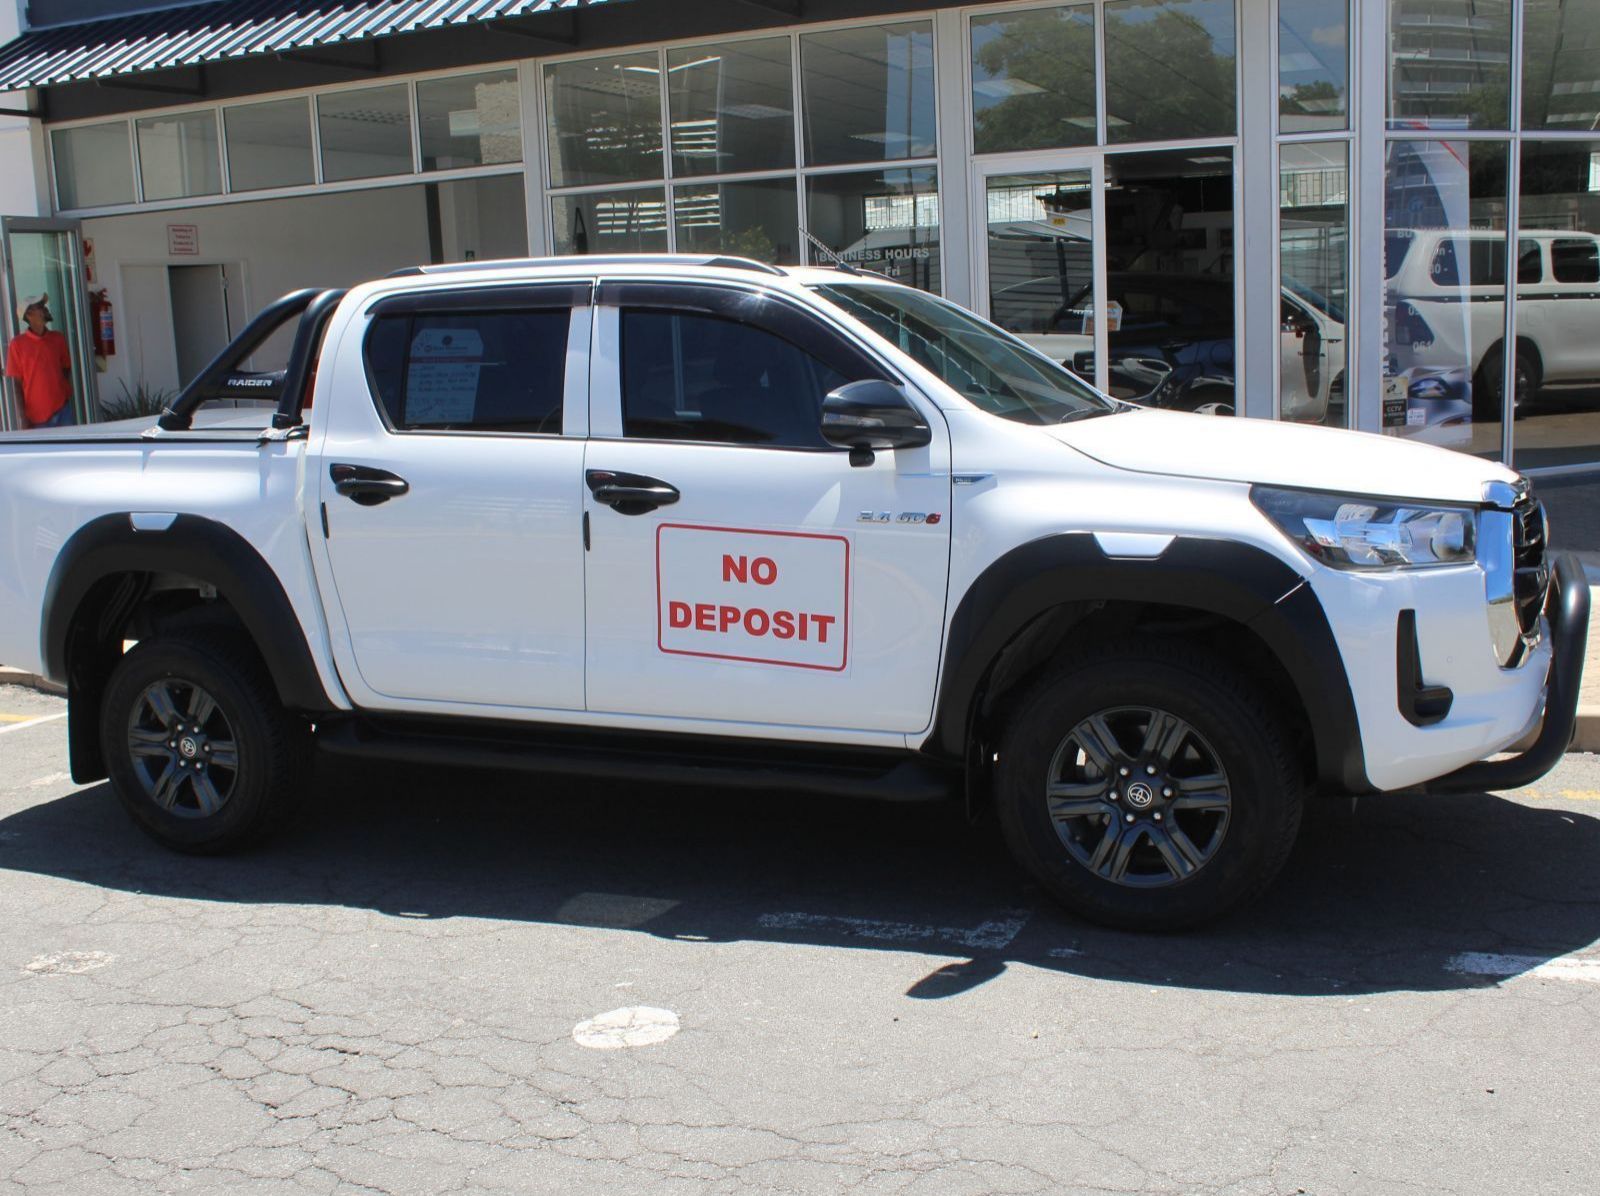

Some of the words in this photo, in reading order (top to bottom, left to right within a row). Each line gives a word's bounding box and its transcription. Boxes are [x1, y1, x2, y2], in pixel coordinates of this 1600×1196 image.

[885, 248, 930, 259] HOURS
[884, 266, 900, 276] Fri
[722, 554, 778, 586] NO
[669, 600, 836, 643] DEPOSIT
